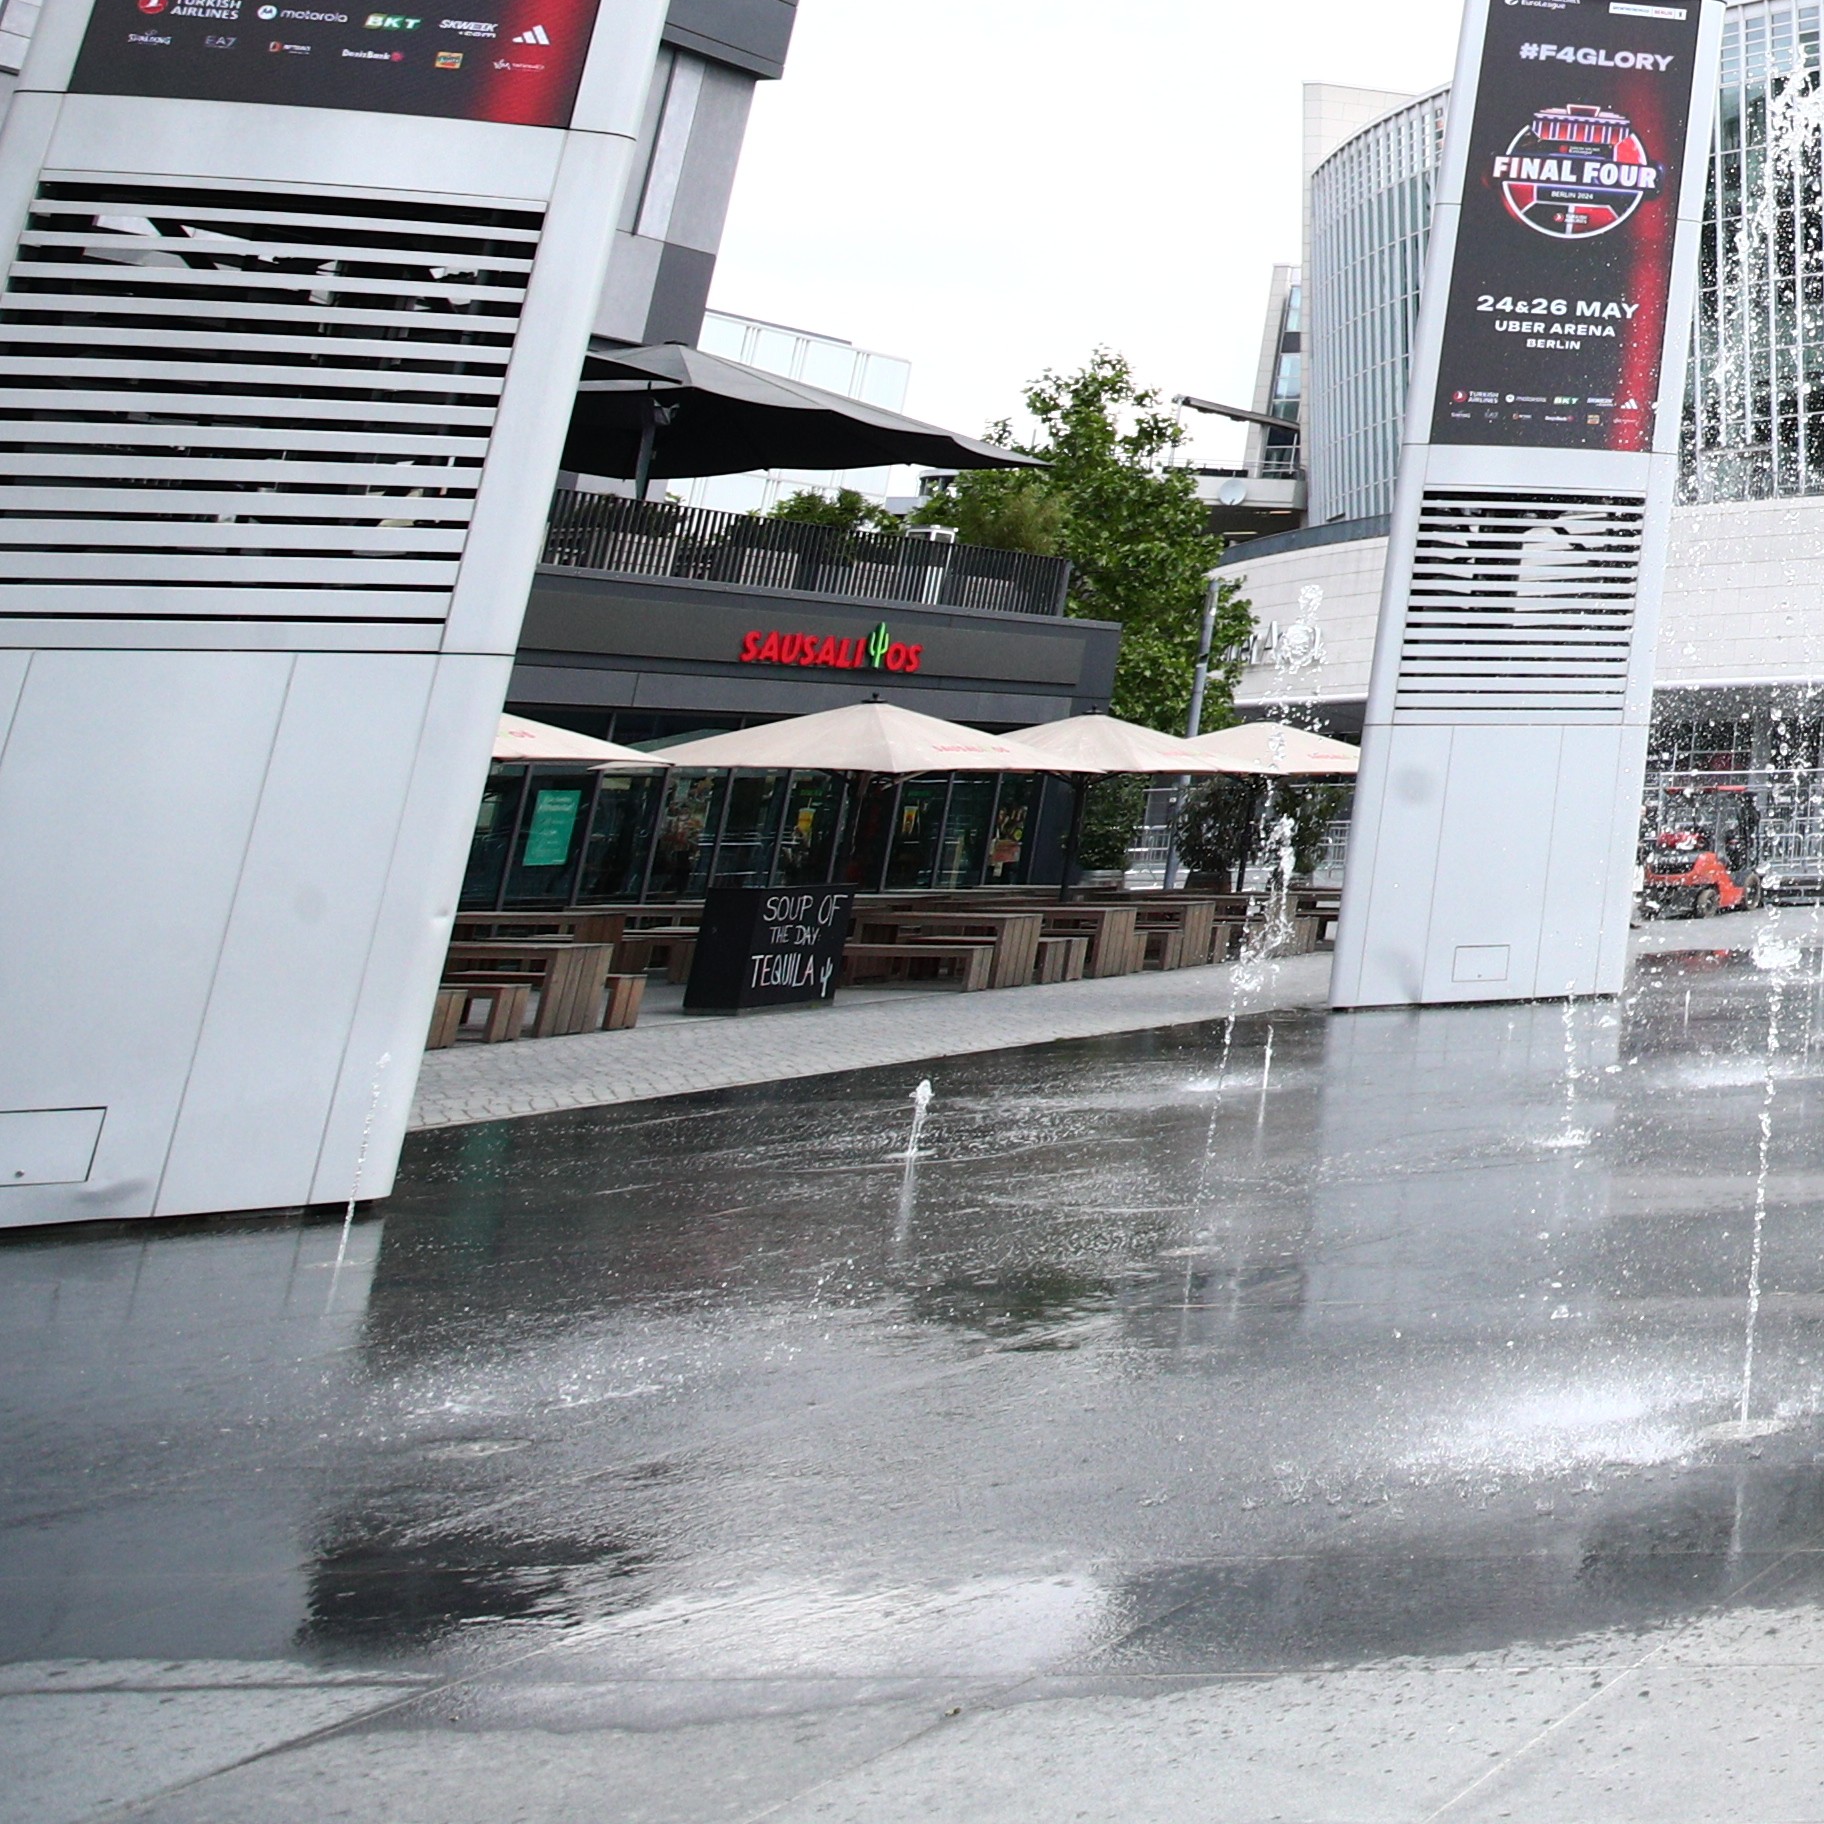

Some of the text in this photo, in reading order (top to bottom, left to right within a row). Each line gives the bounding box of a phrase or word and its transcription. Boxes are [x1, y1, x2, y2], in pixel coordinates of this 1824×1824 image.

[170, 6, 240, 20] AIRLINES
[280, 9, 348, 23] motorola
[365, 14, 421, 29] BKT
[1519, 42, 1674, 72] #F4GLORY
[1492, 155, 1657, 188] FINAL FOUR
[1476, 294, 1640, 319] 24&26 MAY
[1495, 320, 1616, 337] UBER ARENA
[1526, 338, 1581, 350] BERLIN
[763, 894, 849, 927] SOUP OF
[769, 925, 793, 944] THE
[751, 952, 815, 989] TEQUILA
